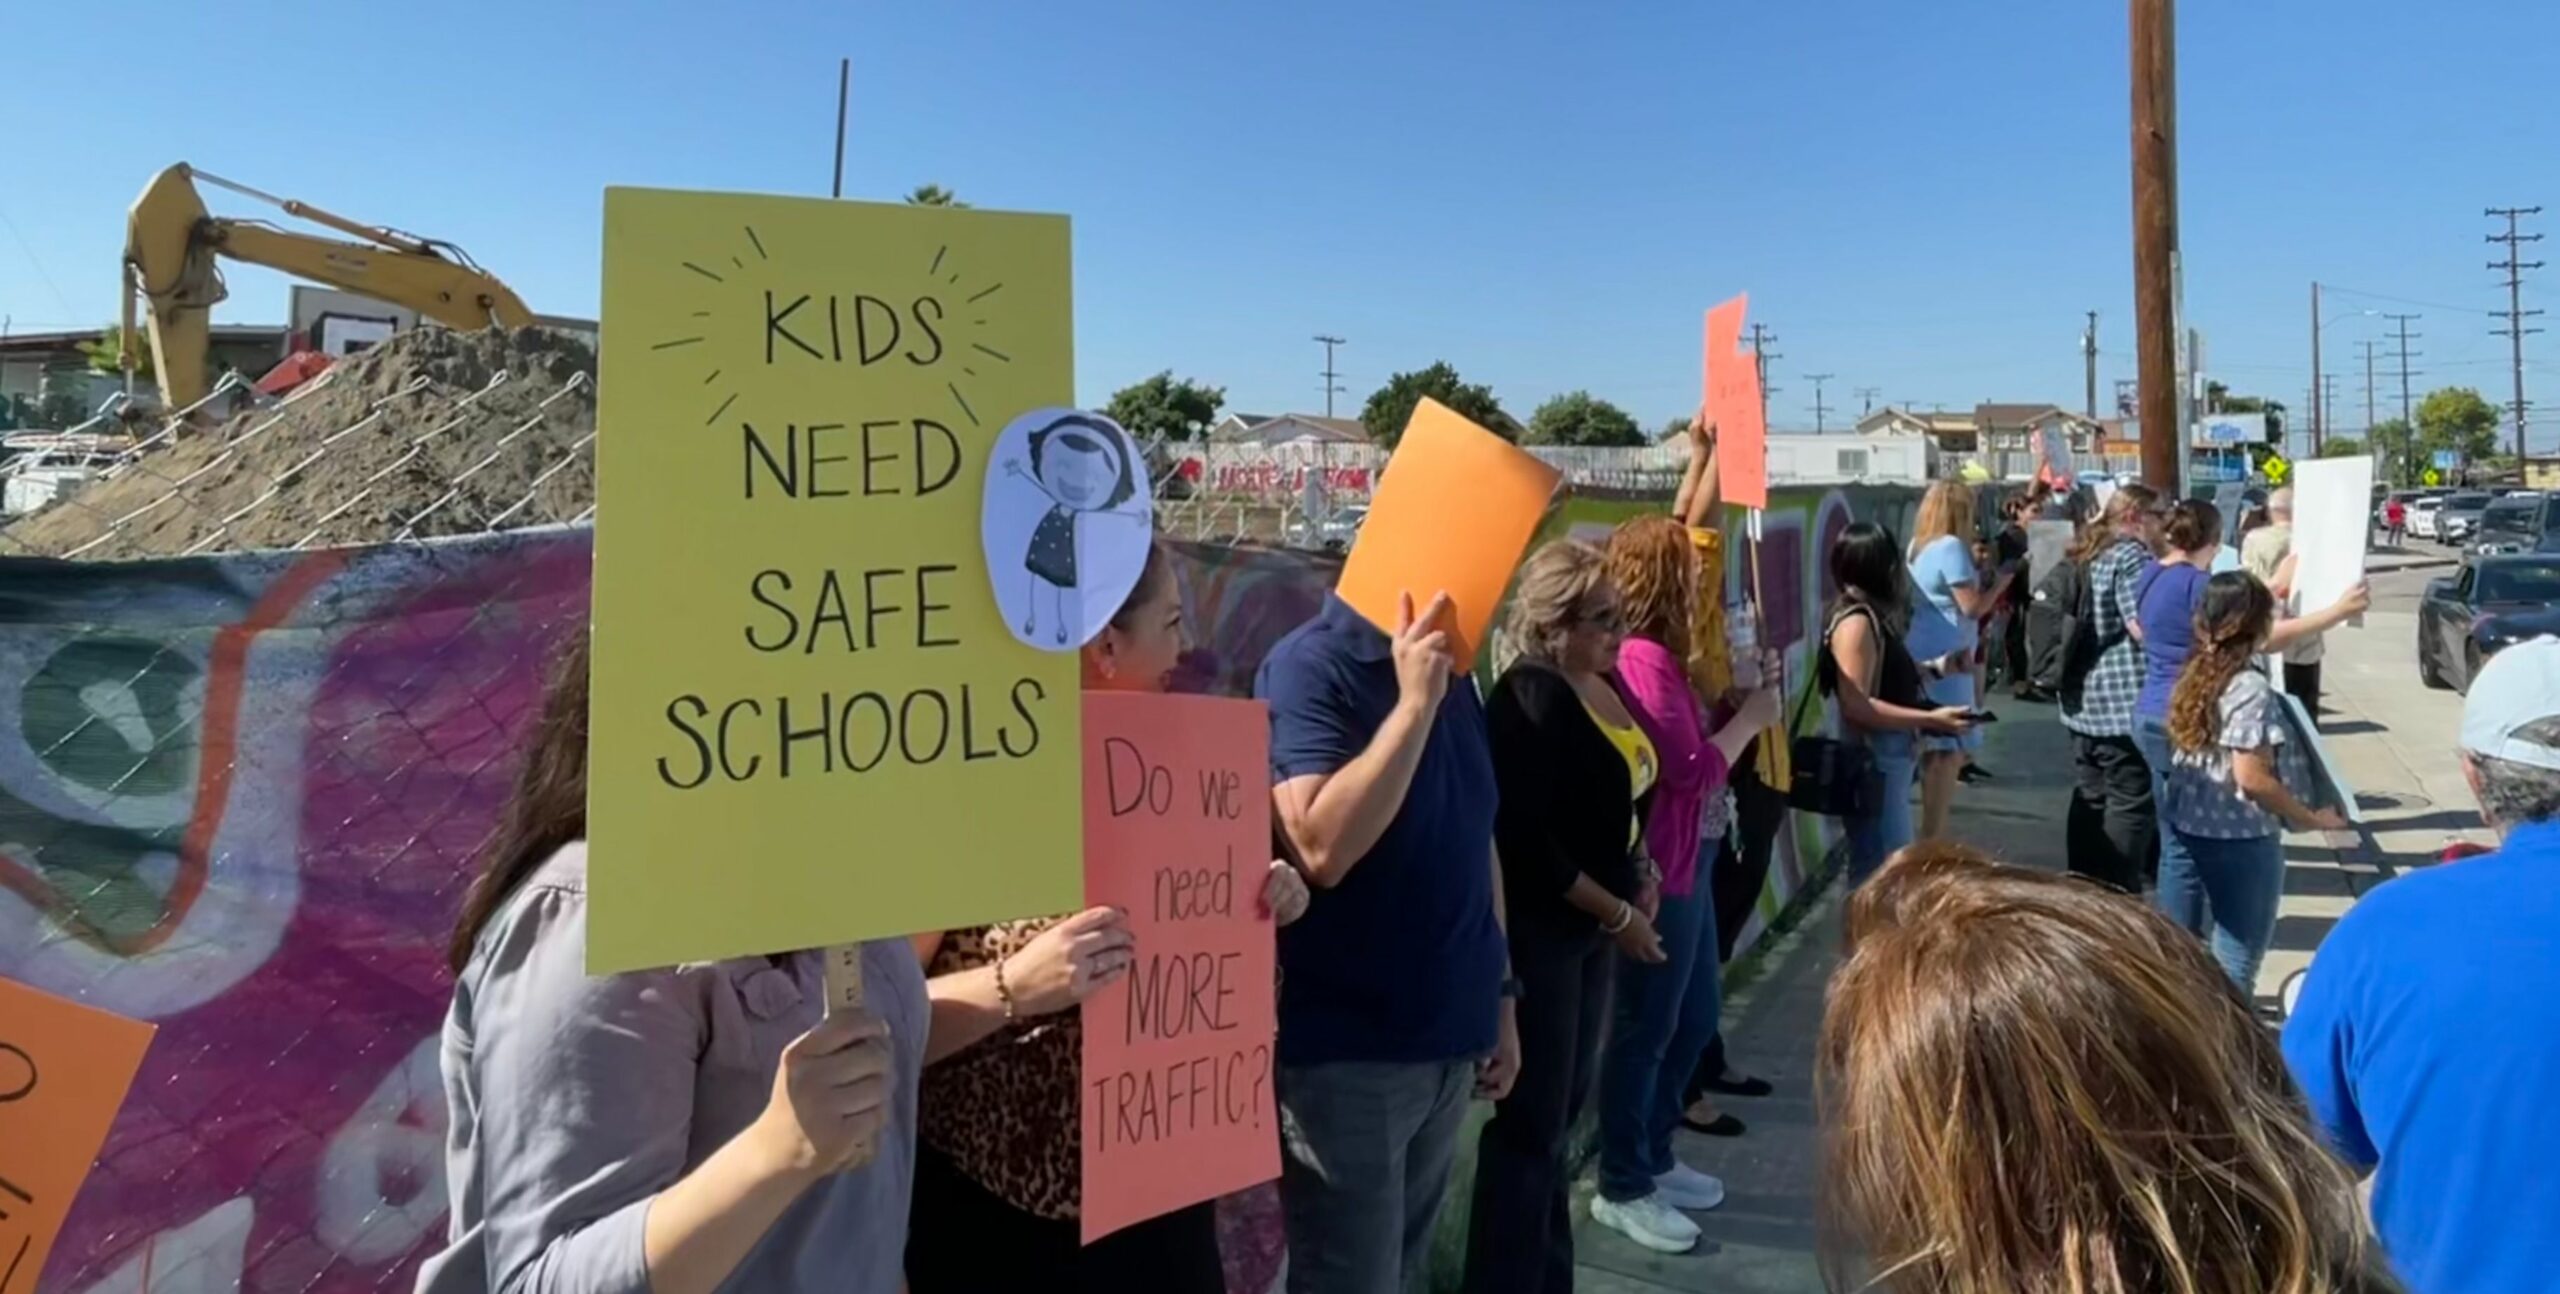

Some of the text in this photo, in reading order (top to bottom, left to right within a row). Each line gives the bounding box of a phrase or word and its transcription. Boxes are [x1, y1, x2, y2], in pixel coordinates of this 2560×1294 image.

[766, 290, 943, 366] KIDS
[742, 419, 962, 499] NEED
[744, 565, 961, 654] SAFE
[656, 678, 1046, 788] SCHOOLS
[1104, 737, 1242, 820] Do we
[1154, 844, 1232, 923] need
[1126, 951, 1242, 1046] MORE
[1093, 1044, 1269, 1152] TRAFFIC?
